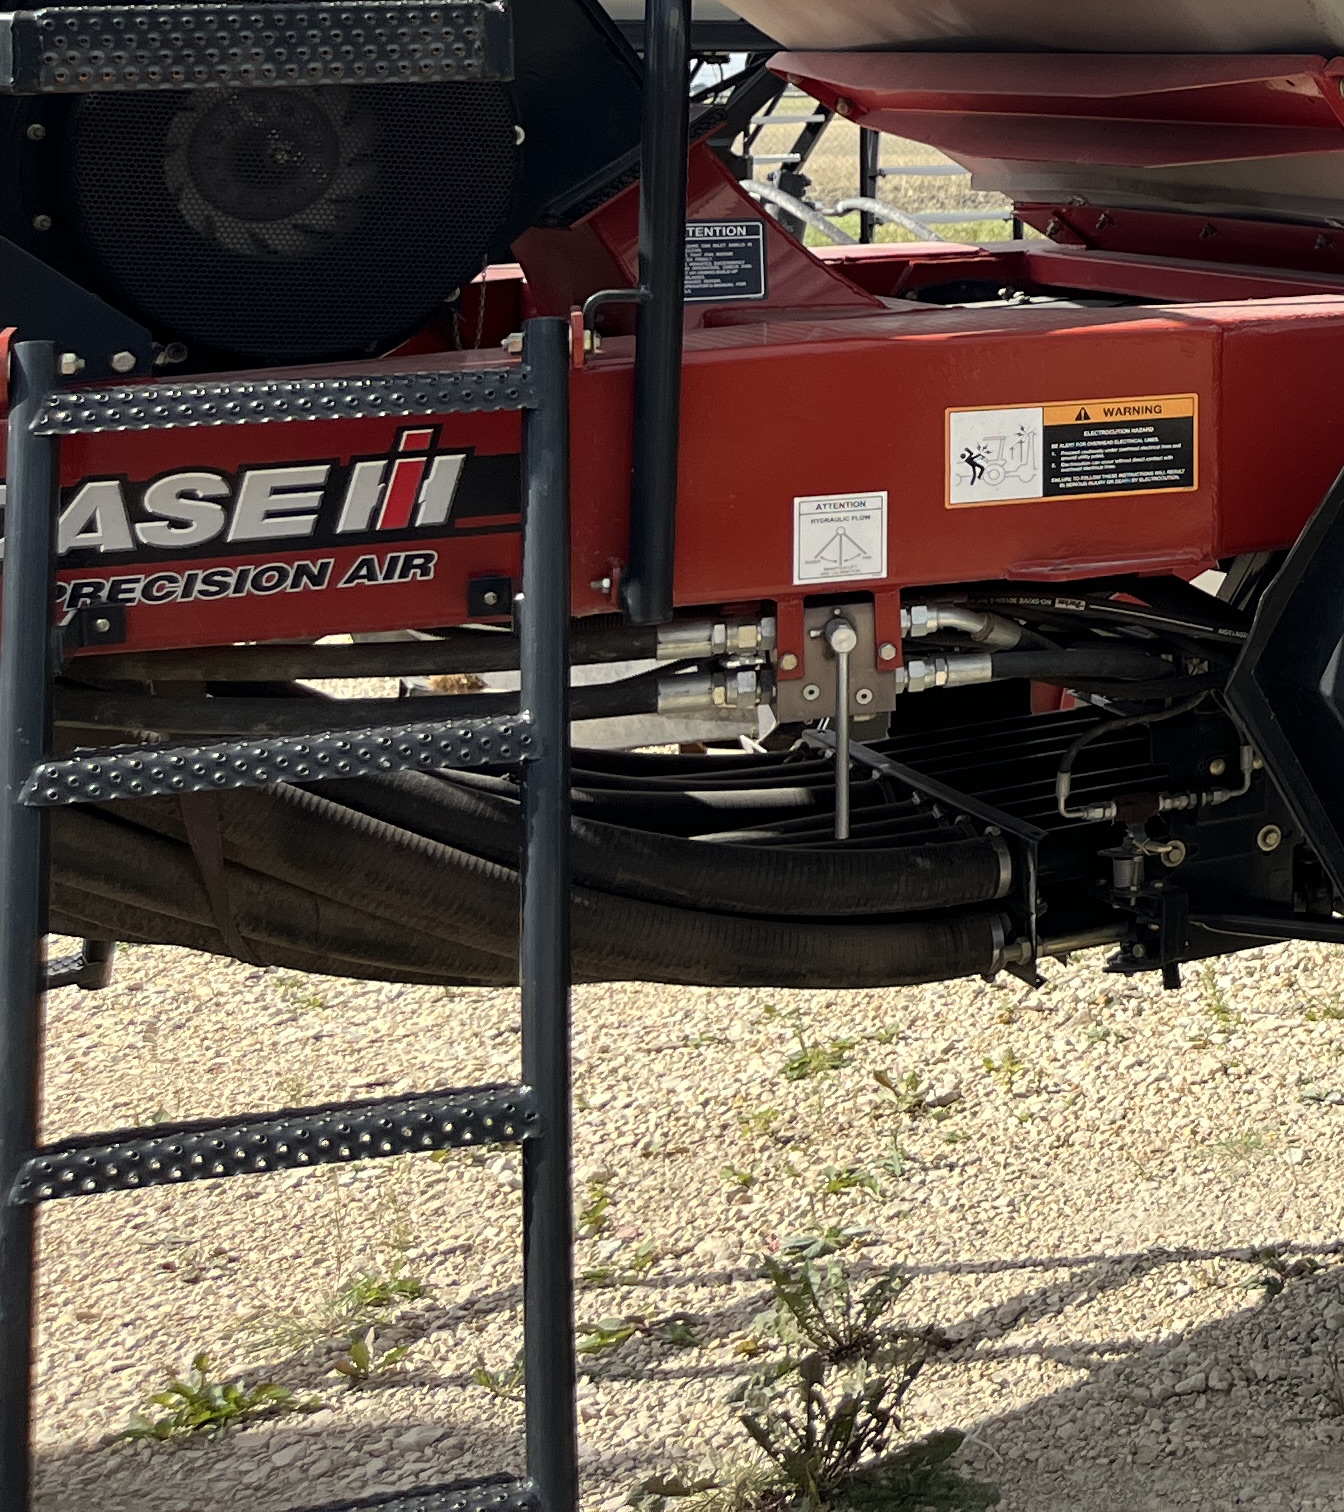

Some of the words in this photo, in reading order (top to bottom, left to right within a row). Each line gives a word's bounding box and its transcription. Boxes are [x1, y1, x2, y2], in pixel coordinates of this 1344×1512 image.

[686, 226, 747, 237] TENTION
[1103, 405, 1163, 417] WARNING
[0, 464, 333, 554] ASE
[816, 500, 866, 510] ATTENTION
[810, 515, 850, 524] HYDRAULIC
[338, 550, 438, 587] AIR
